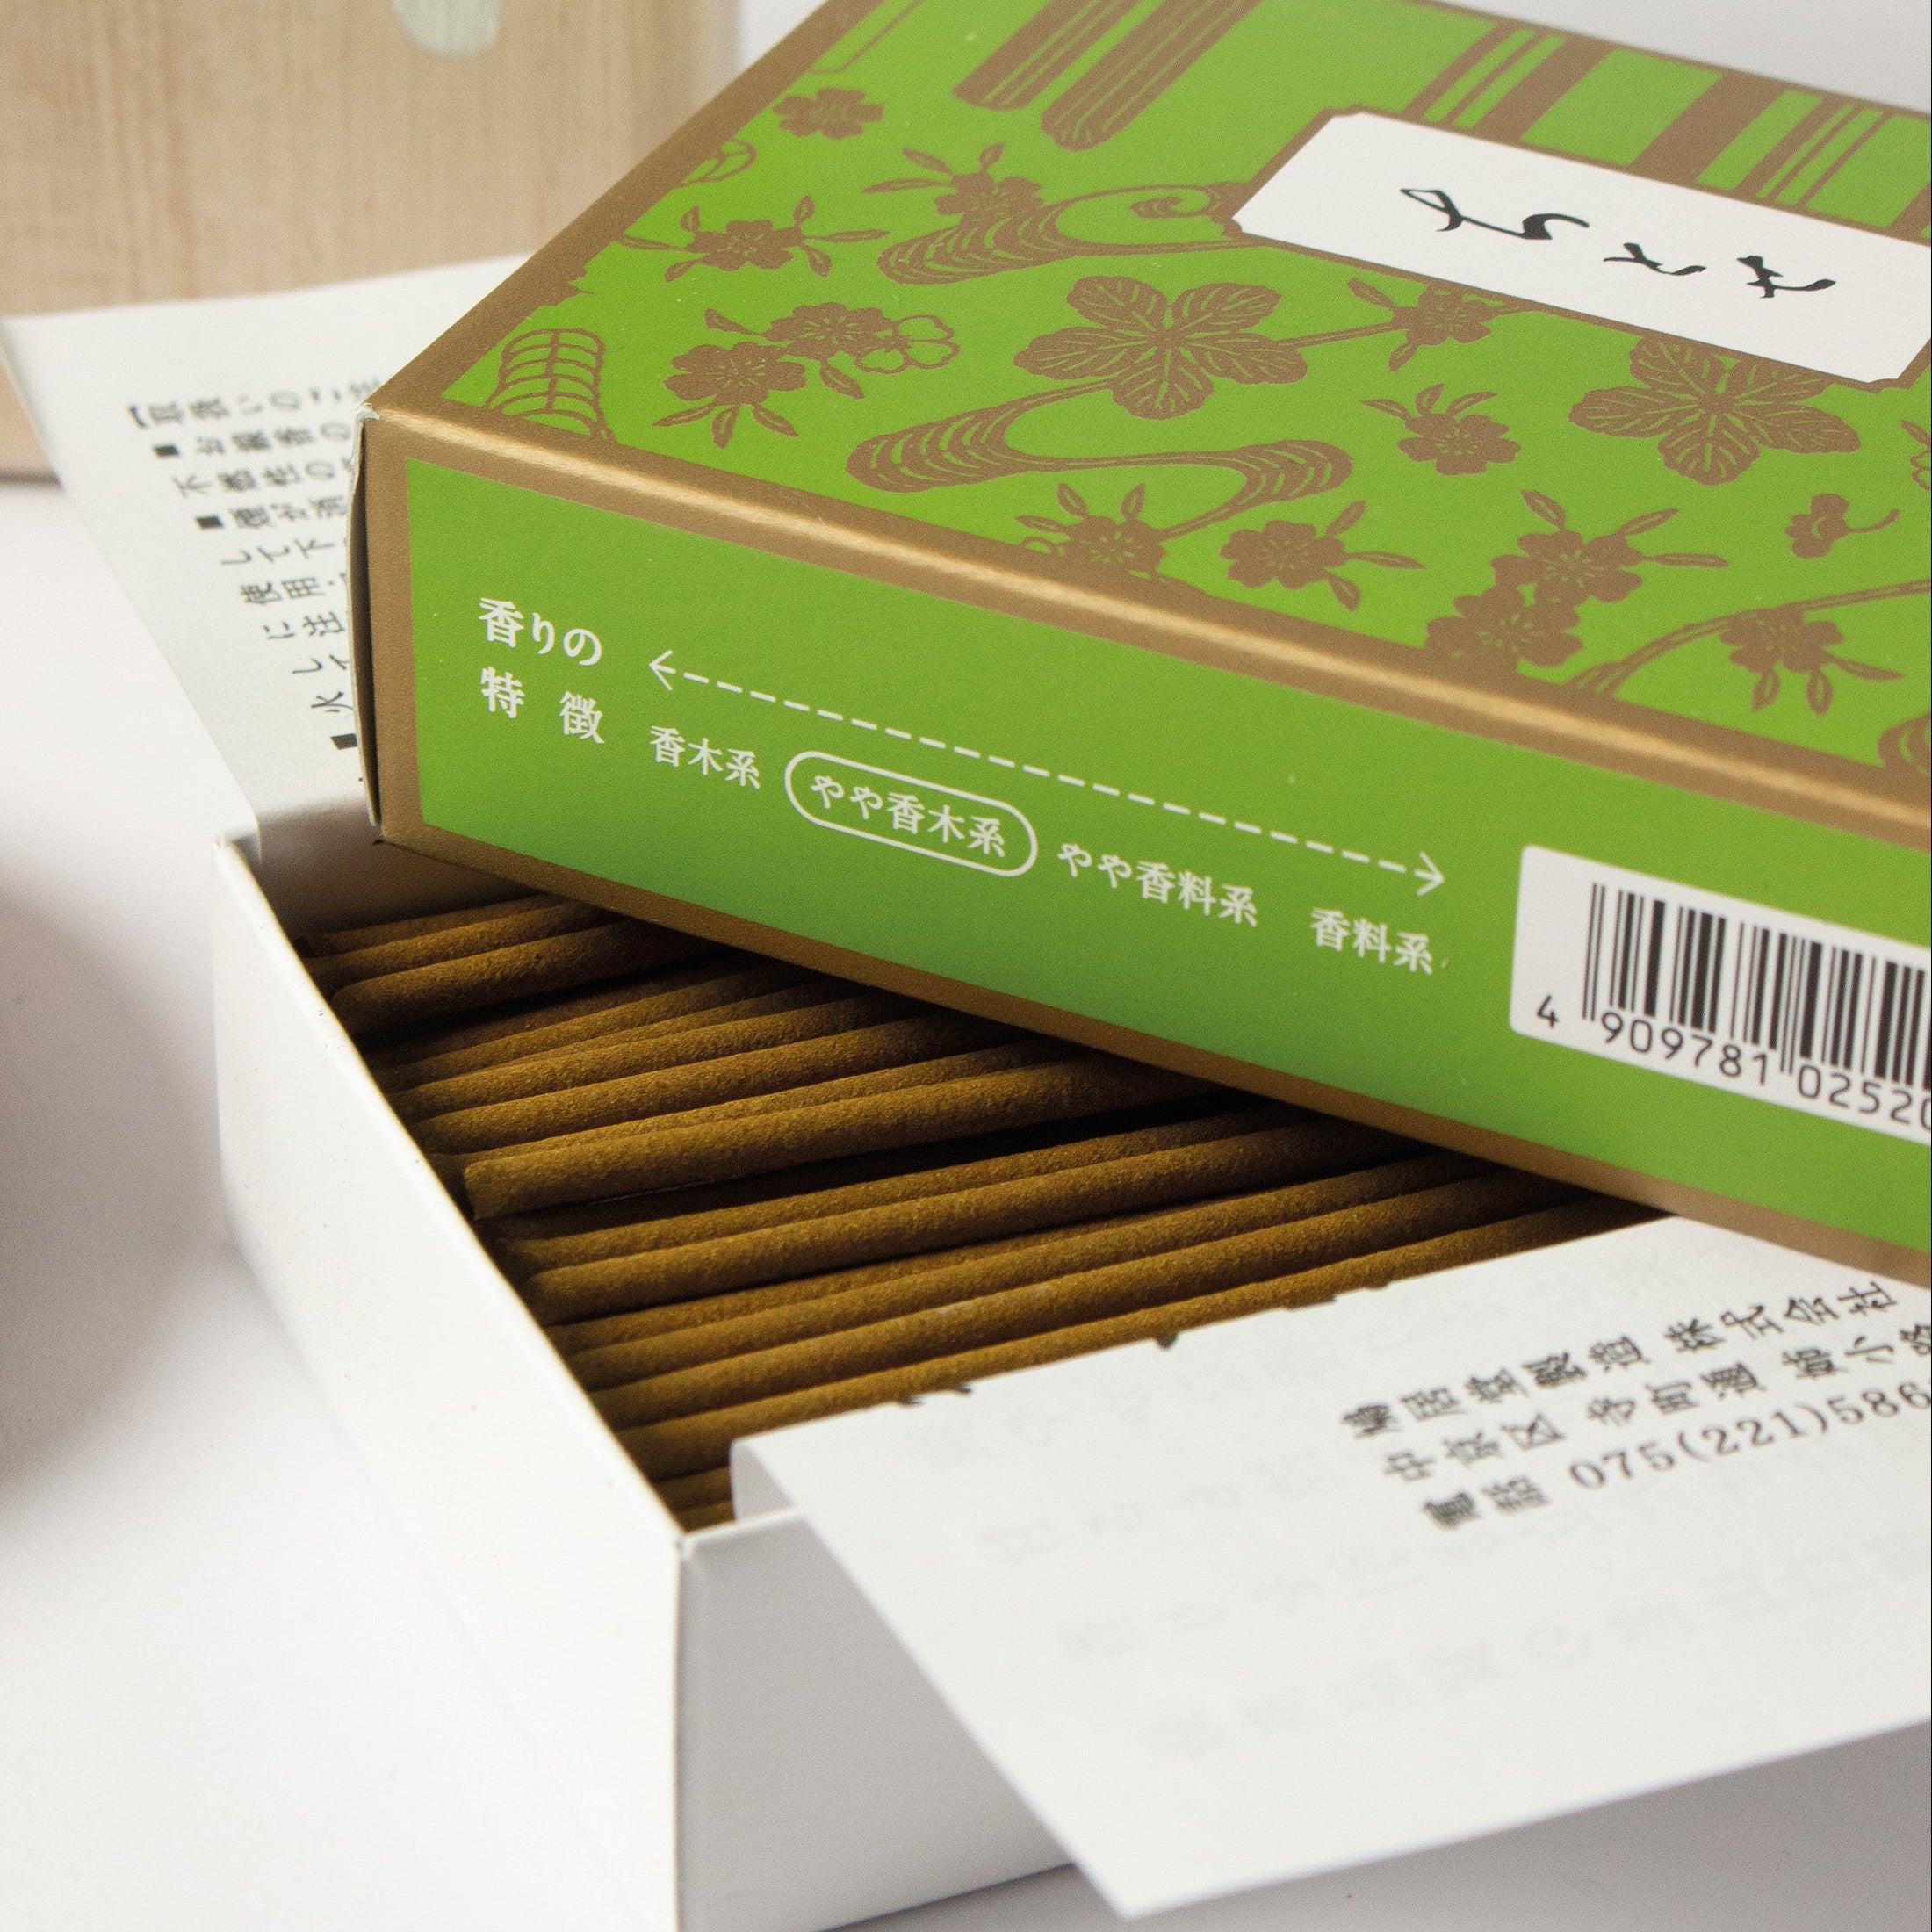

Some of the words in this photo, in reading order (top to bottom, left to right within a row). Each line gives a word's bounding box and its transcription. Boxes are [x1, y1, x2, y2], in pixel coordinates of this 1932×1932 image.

[479, 597, 602, 666] 香りの
[649, 725, 761, 789] 香木系
[810, 775, 1006, 858] やや香木系
[1056, 843, 1258, 927] やや香料系
[1310, 908, 1433, 975] 香料系
[1536, 995, 1559, 1028] 4
[1600, 1011, 1769, 1085] 909781
